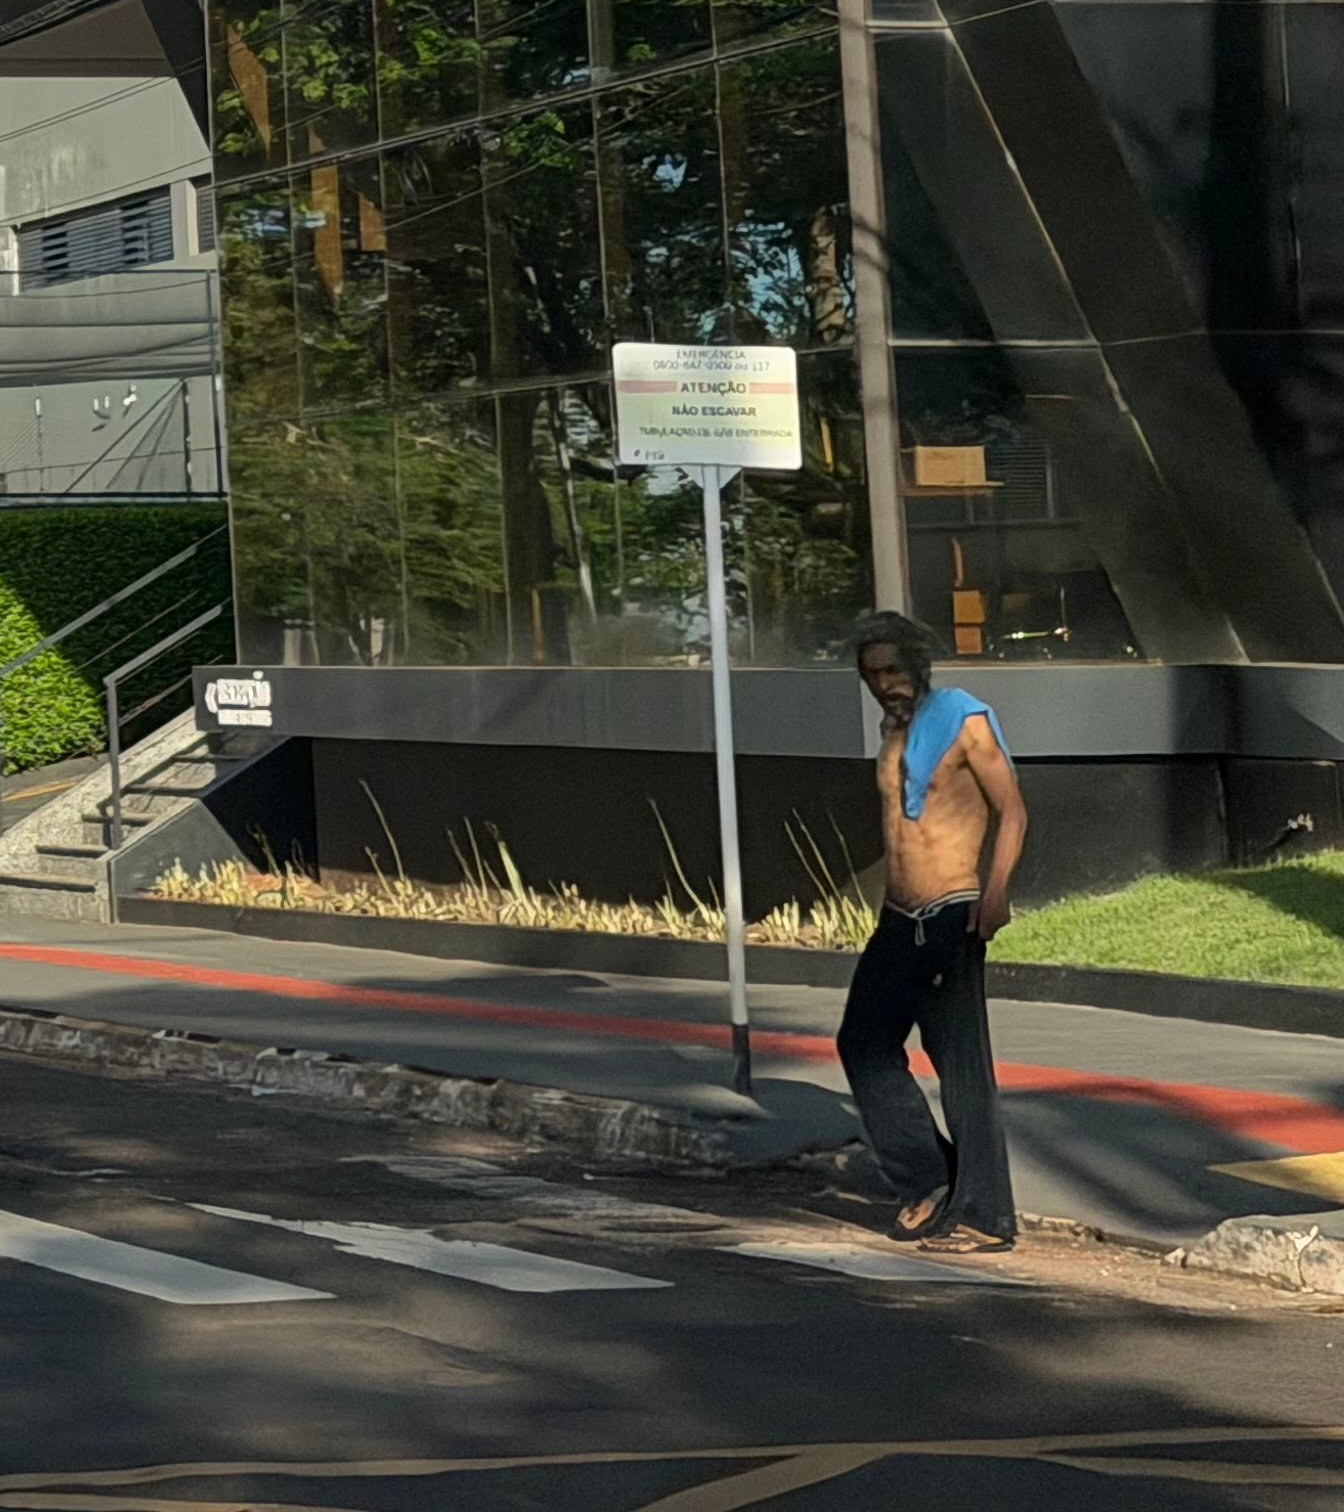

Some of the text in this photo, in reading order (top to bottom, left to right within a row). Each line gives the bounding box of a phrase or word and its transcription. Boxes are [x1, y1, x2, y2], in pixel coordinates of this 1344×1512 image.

[680, 380, 746, 397] ATENÇÃO
[672, 402, 757, 417] NÃO ESCAVAR
